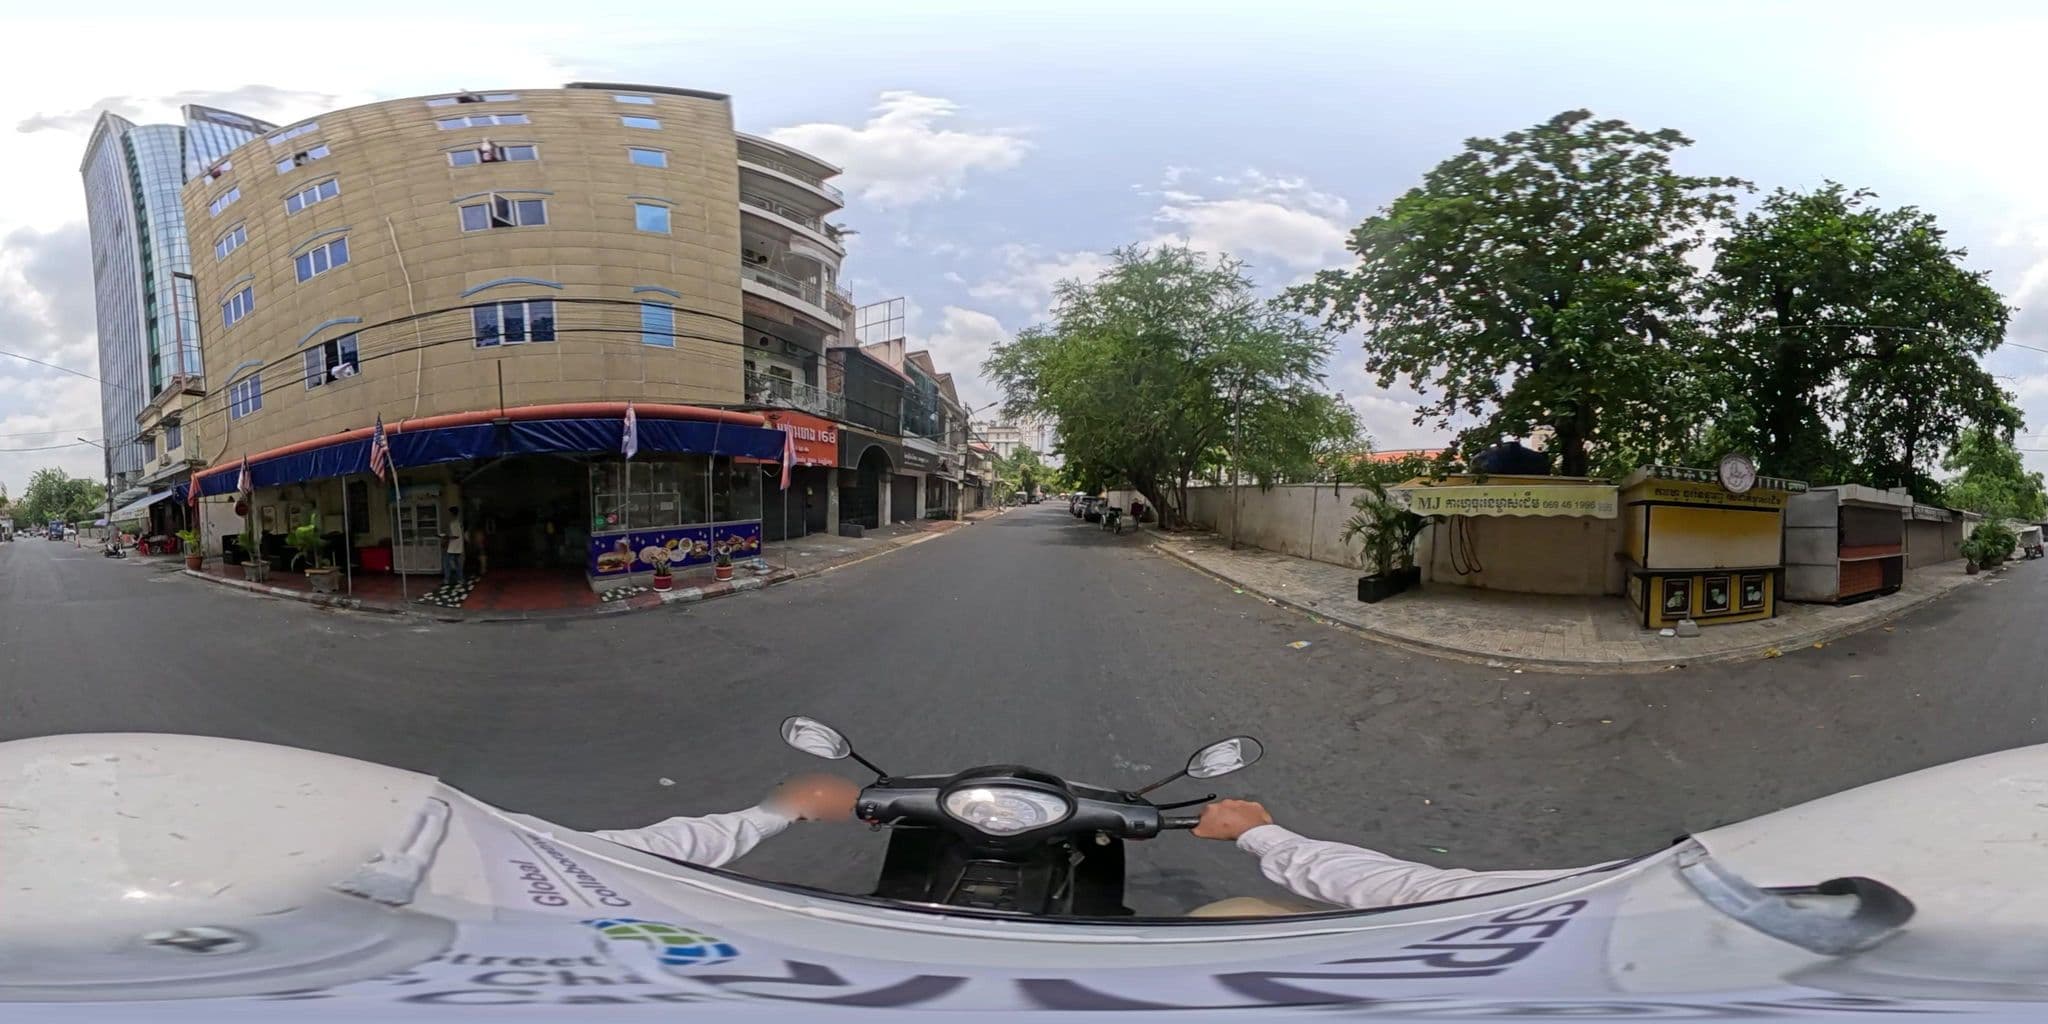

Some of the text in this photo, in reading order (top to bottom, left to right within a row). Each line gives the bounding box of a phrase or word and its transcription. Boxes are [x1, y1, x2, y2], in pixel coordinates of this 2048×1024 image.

[818, 430, 836, 444] 168
[1418, 497, 1441, 511] MJ
[508, 859, 570, 907] Global
